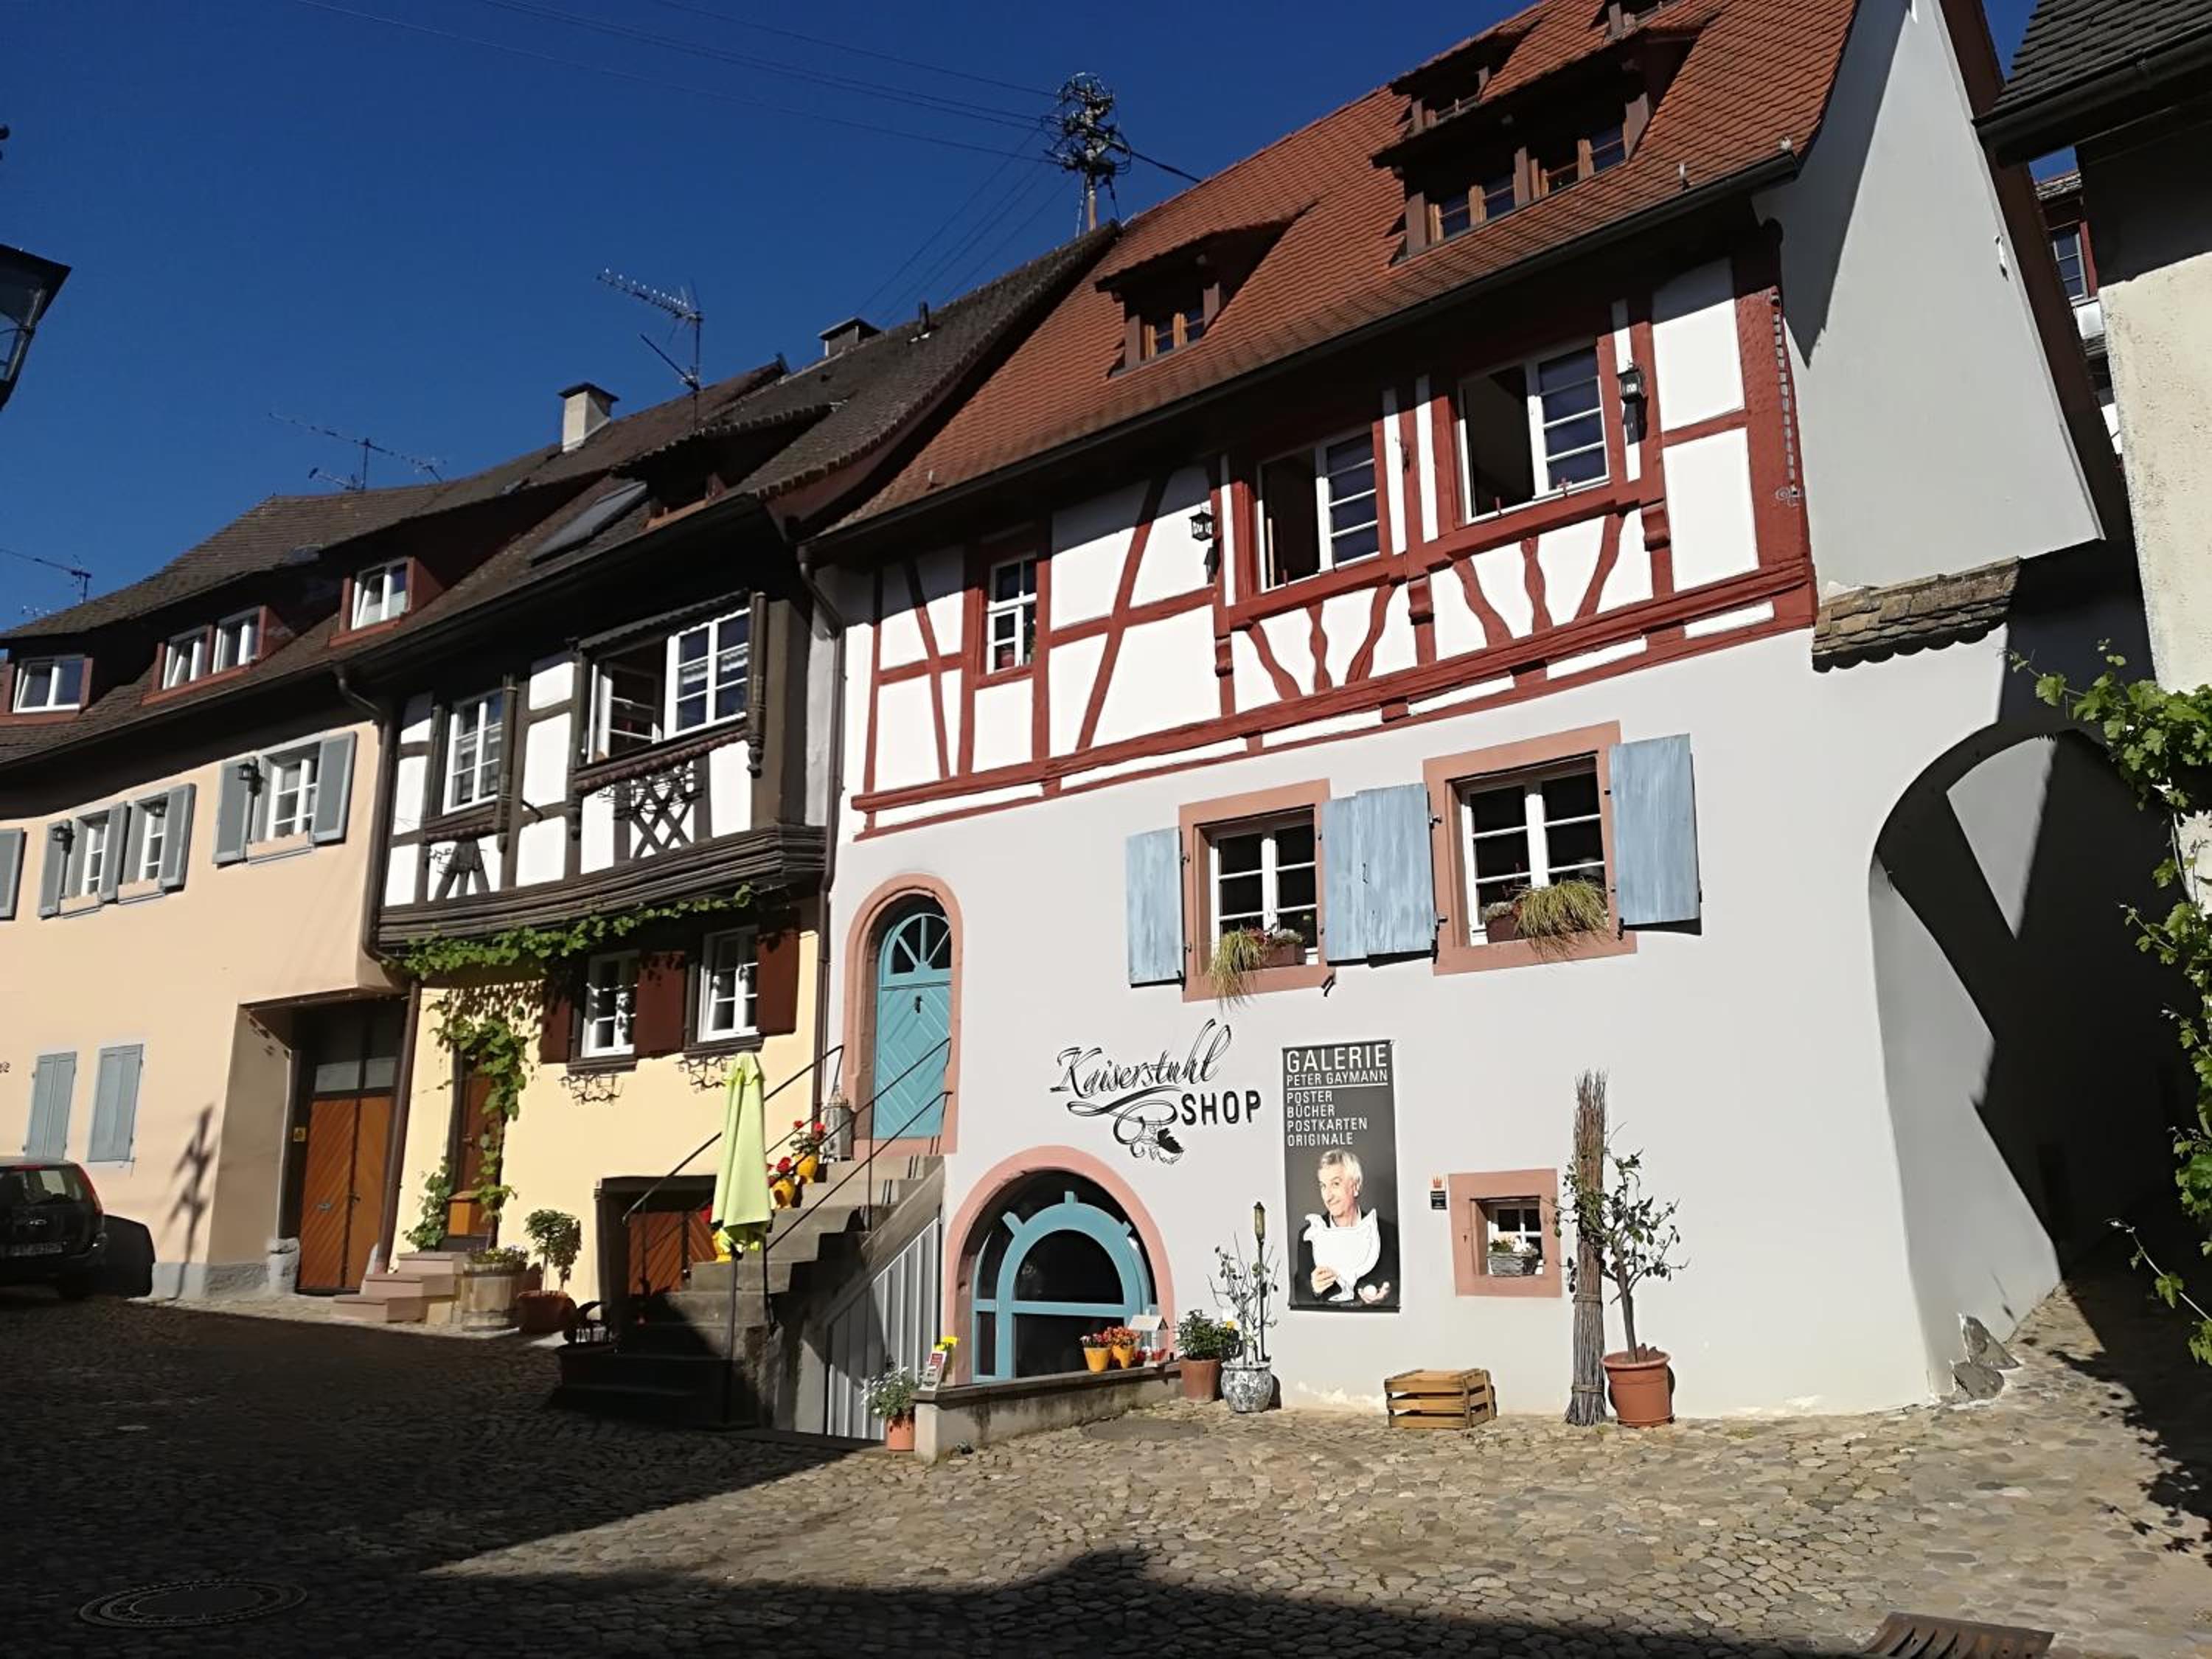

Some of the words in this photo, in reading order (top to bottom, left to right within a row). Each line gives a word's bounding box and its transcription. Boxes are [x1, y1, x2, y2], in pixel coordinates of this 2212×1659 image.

[1050, 1018, 1231, 1099] Kaiserstuhl
[1287, 1044, 1387, 1073] GALERIE
[1287, 1073, 1321, 1087] PETER
[1326, 1068, 1388, 1085] GAYMANN
[1287, 1090, 1332, 1103] POSTER
[1181, 1091, 1261, 1125] SHOP
[1287, 1104, 1335, 1119] BÜCHER
[1287, 1117, 1368, 1132] POSTKARTEN
[1287, 1132, 1354, 1147] ORIGINALE
